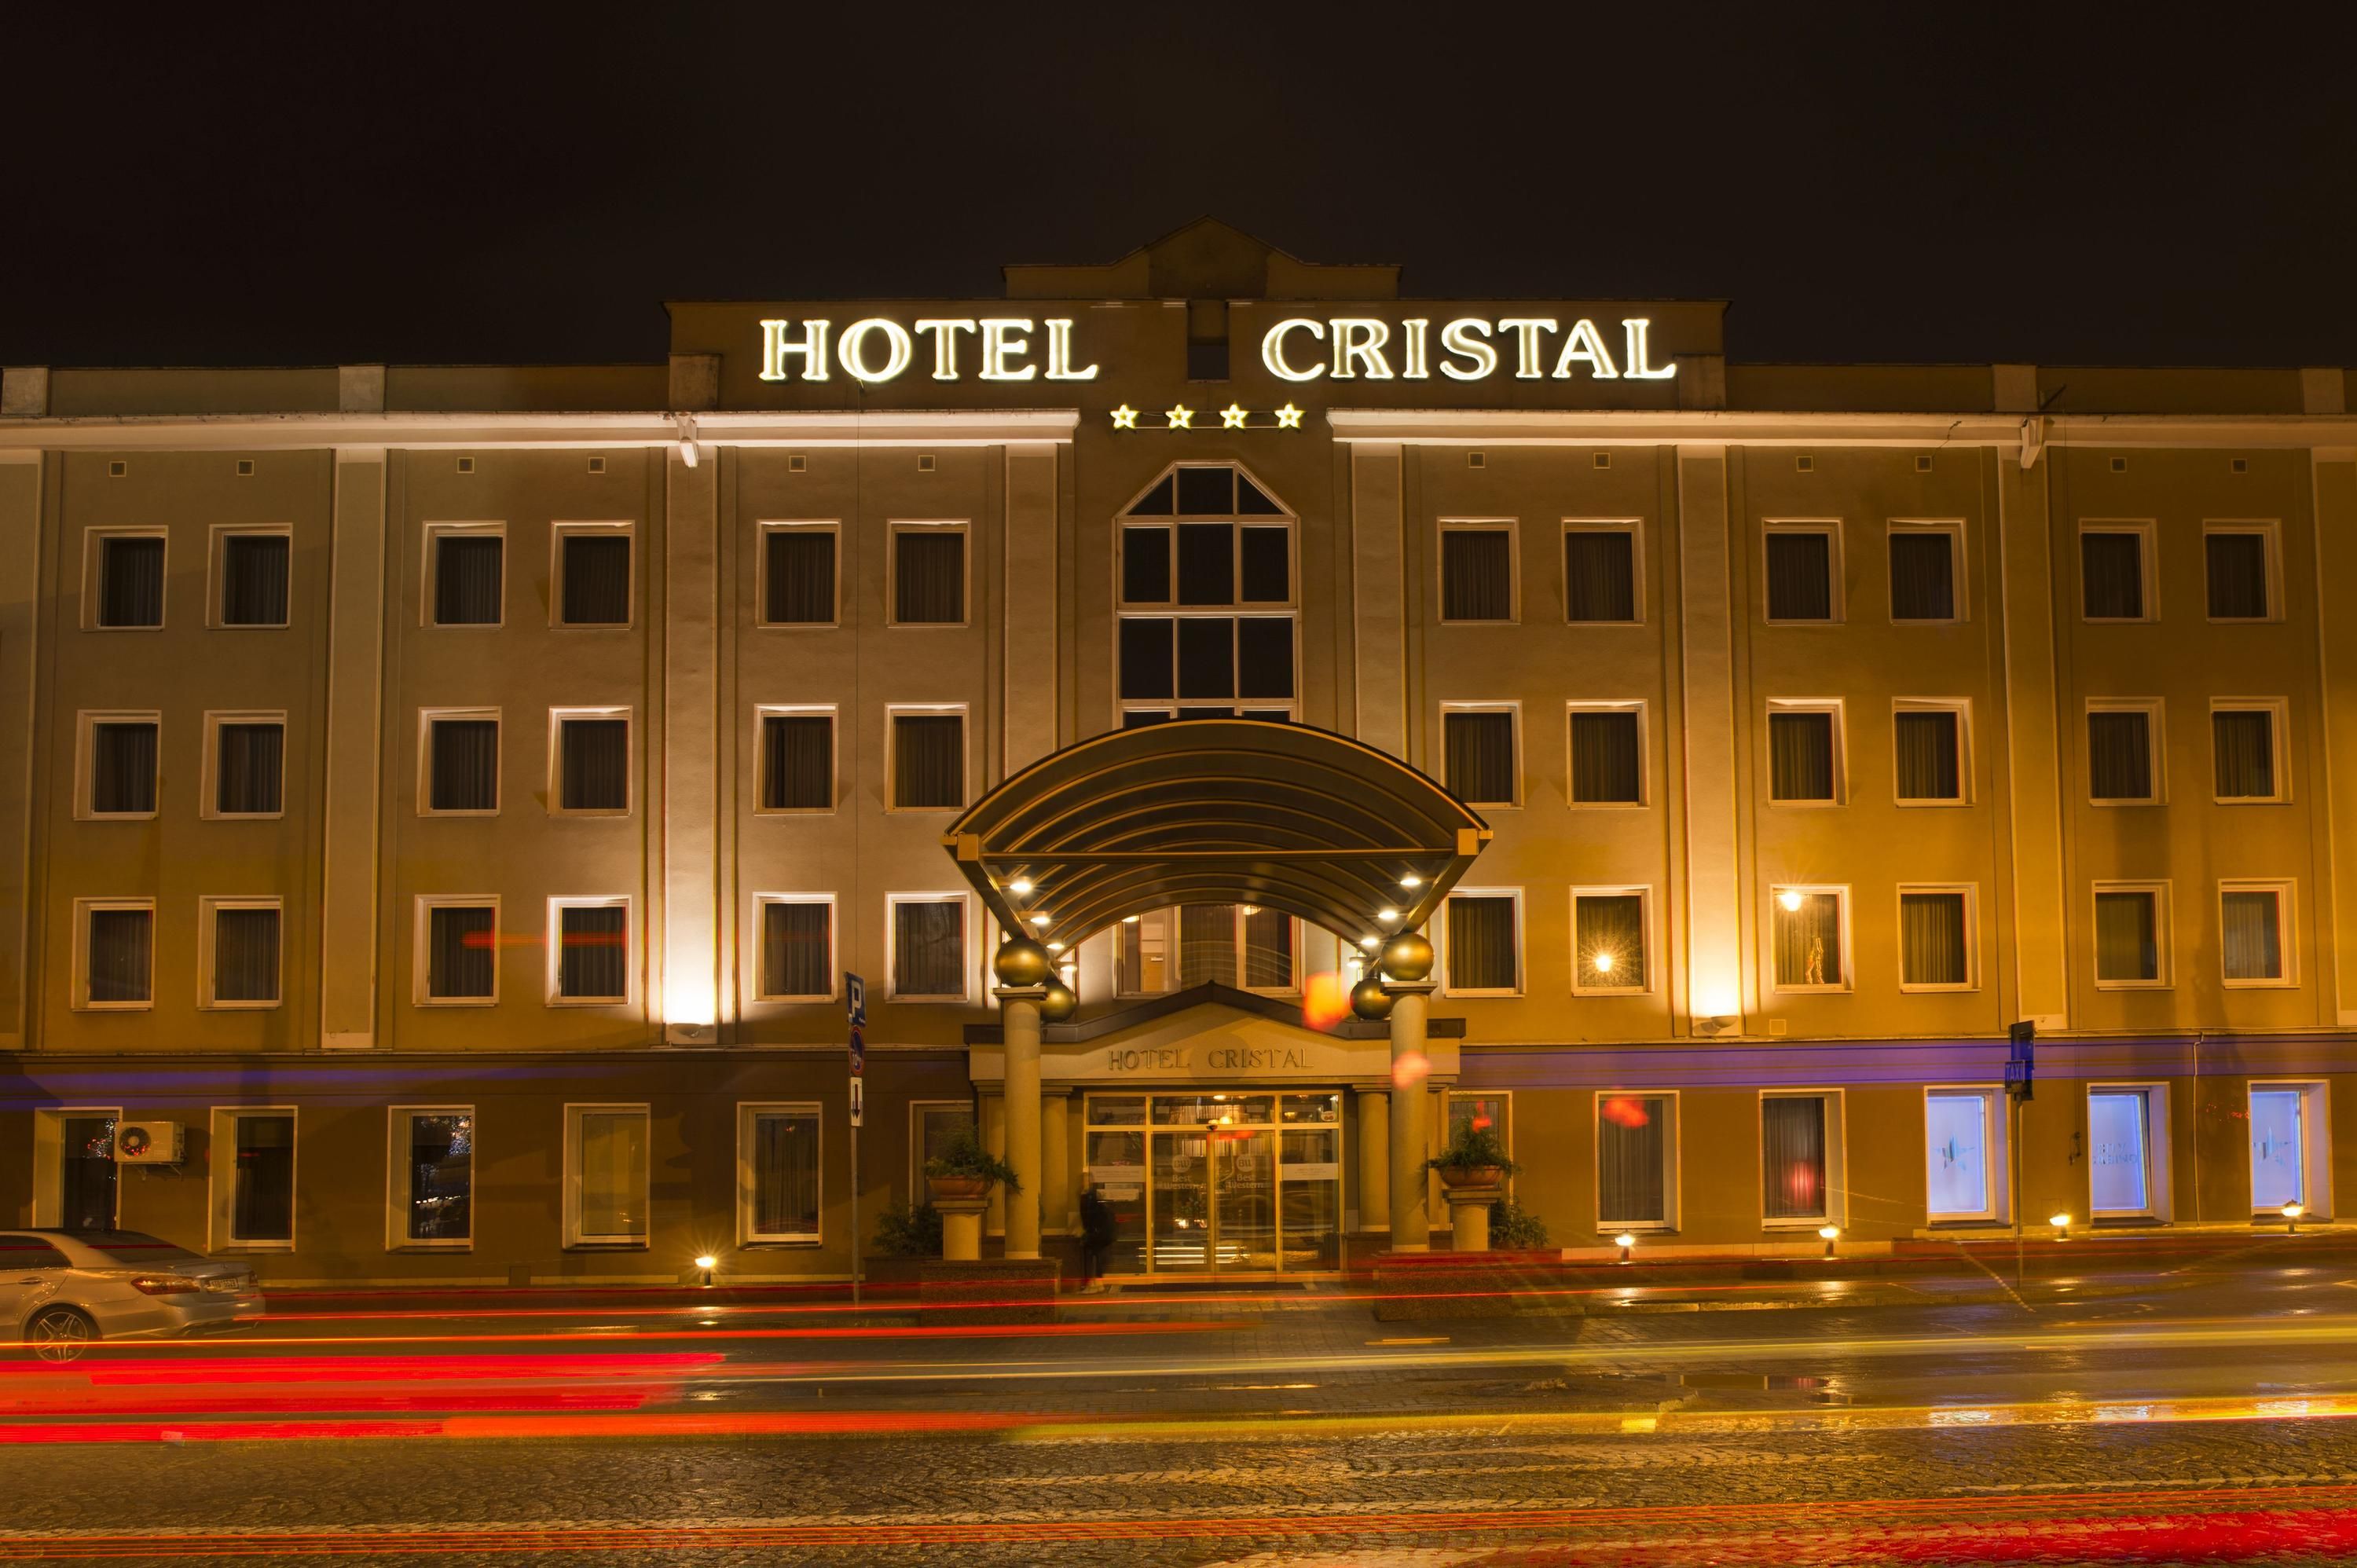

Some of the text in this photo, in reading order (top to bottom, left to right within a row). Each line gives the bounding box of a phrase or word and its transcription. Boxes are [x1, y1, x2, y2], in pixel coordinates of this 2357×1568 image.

[758, 317, 1678, 383] HOTEL CRISTAL
[851, 980, 862, 1018] P
[1108, 1048, 1314, 1070] HOTEL CRISTAL
[2005, 1063, 2023, 1082] TAXI
[1226, 1180, 1264, 1189] Western
